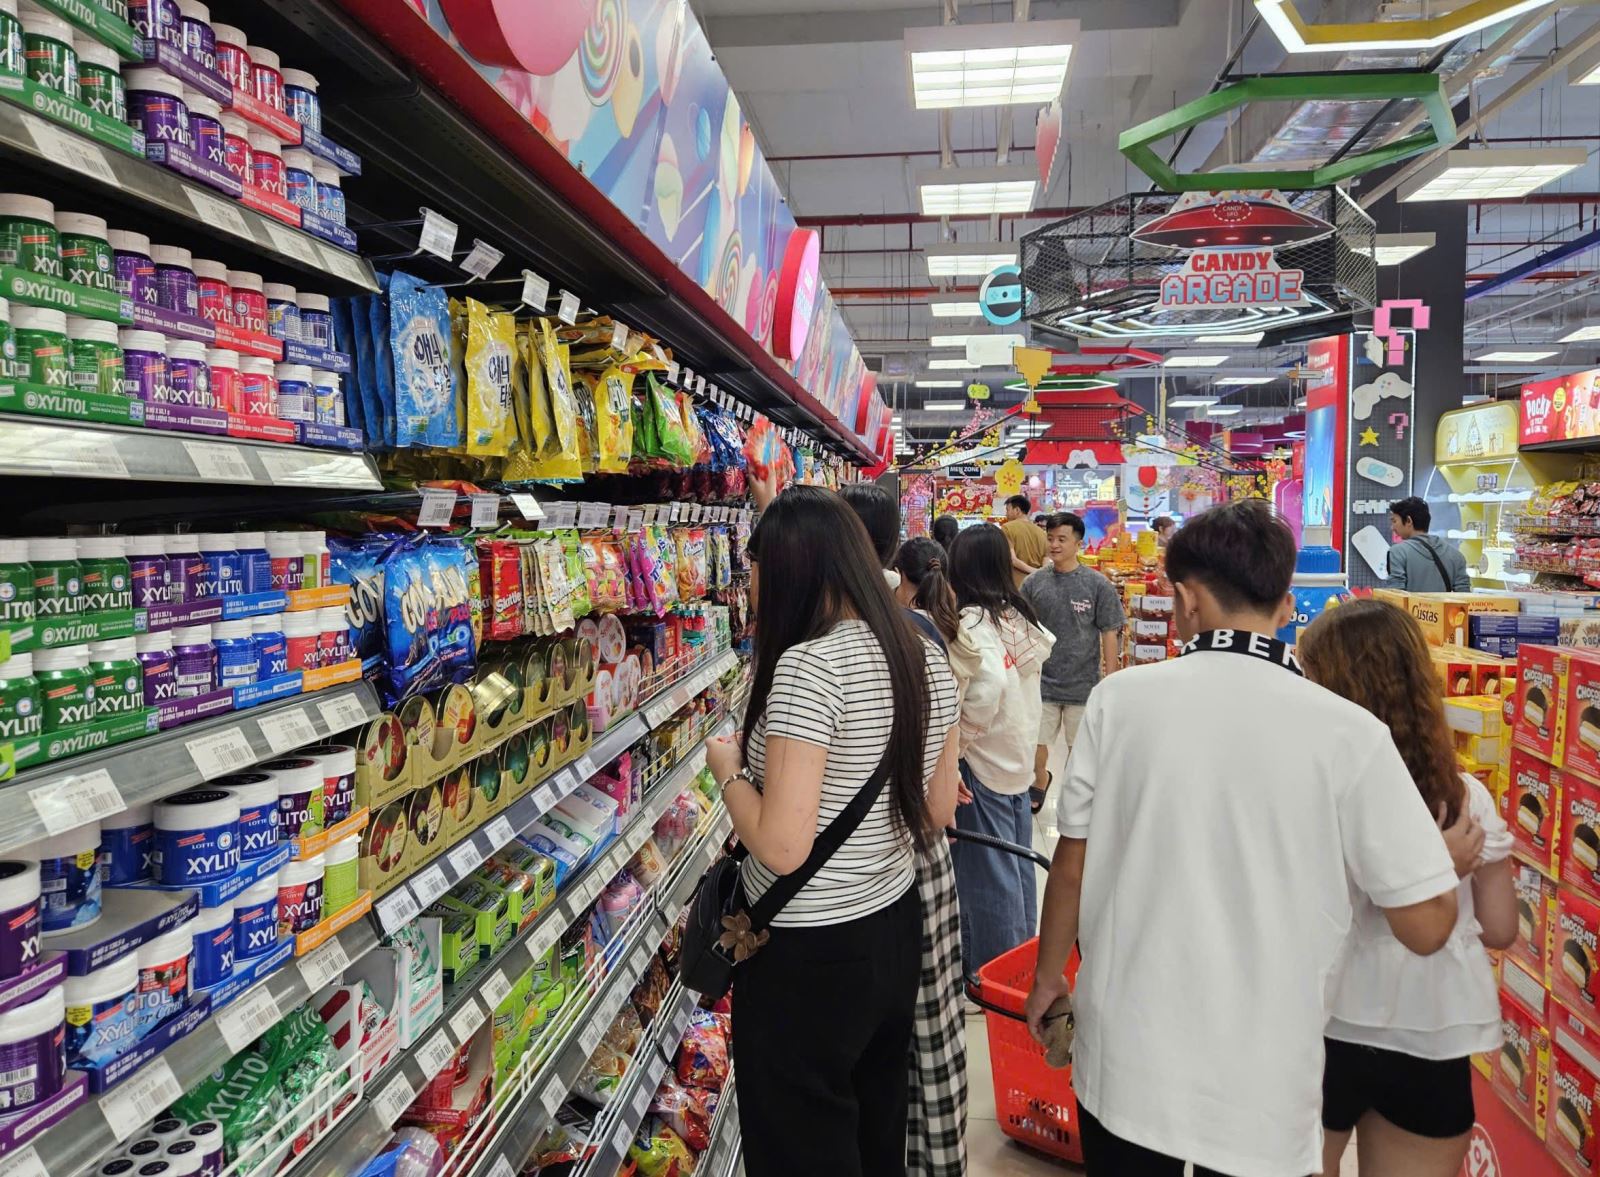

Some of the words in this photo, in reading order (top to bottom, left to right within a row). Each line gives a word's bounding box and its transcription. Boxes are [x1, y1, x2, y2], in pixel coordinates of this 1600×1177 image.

[45, 97, 95, 132] XYLITOL
[1192, 252, 1271, 272] CANDY
[26, 281, 78, 308] XYLITOL
[1162, 271, 1302, 305] ARCADE
[38, 395, 88, 415] XYLITOL
[964, 466, 980, 475] ZONE
[496, 592, 521, 612] Skittle
[1411, 605, 1439, 624] Custas
[55, 623, 99, 642] XYLITOL
[1558, 634, 1578, 648] OCKY
[1523, 668, 1553, 690] CHOCOLATE
[1576, 684, 1600, 707] CHOCO
[62, 730, 109, 753] XYLITOL
[1556, 726, 1562, 743] 2
[1517, 772, 1549, 800] CHOCOLATE
[248, 819, 268, 828] LOTTE
[192, 841, 214, 849] LOTTE
[1560, 913, 1597, 952] CHOCOLATE
[1537, 1072, 1548, 1087] 12
[1537, 1100, 1546, 1120] 2
